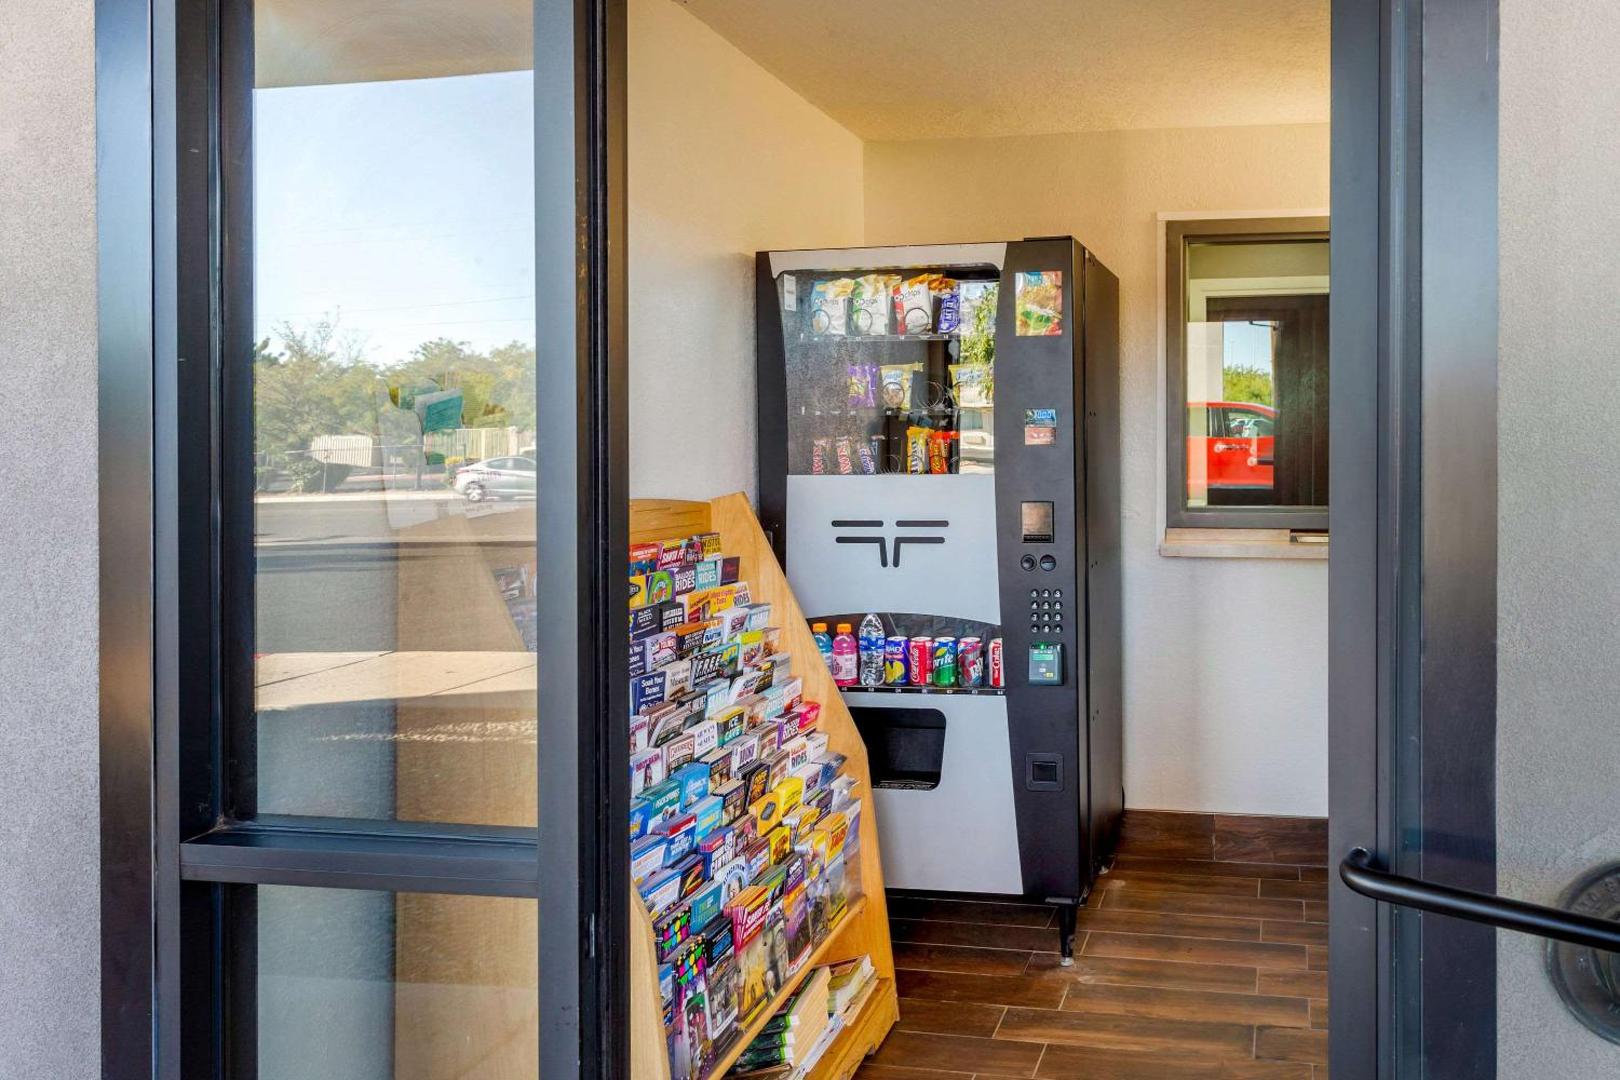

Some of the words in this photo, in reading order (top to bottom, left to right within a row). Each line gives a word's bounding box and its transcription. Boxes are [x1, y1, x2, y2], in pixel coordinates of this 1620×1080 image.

[698, 570, 717, 583] RIDES
[675, 578, 695, 592] RIDES
[697, 655, 721, 673] FREE
[932, 653, 954, 667] prite
[641, 678, 654, 688] Soak
[654, 676, 664, 684] Your
[645, 687, 660, 695] Bones
